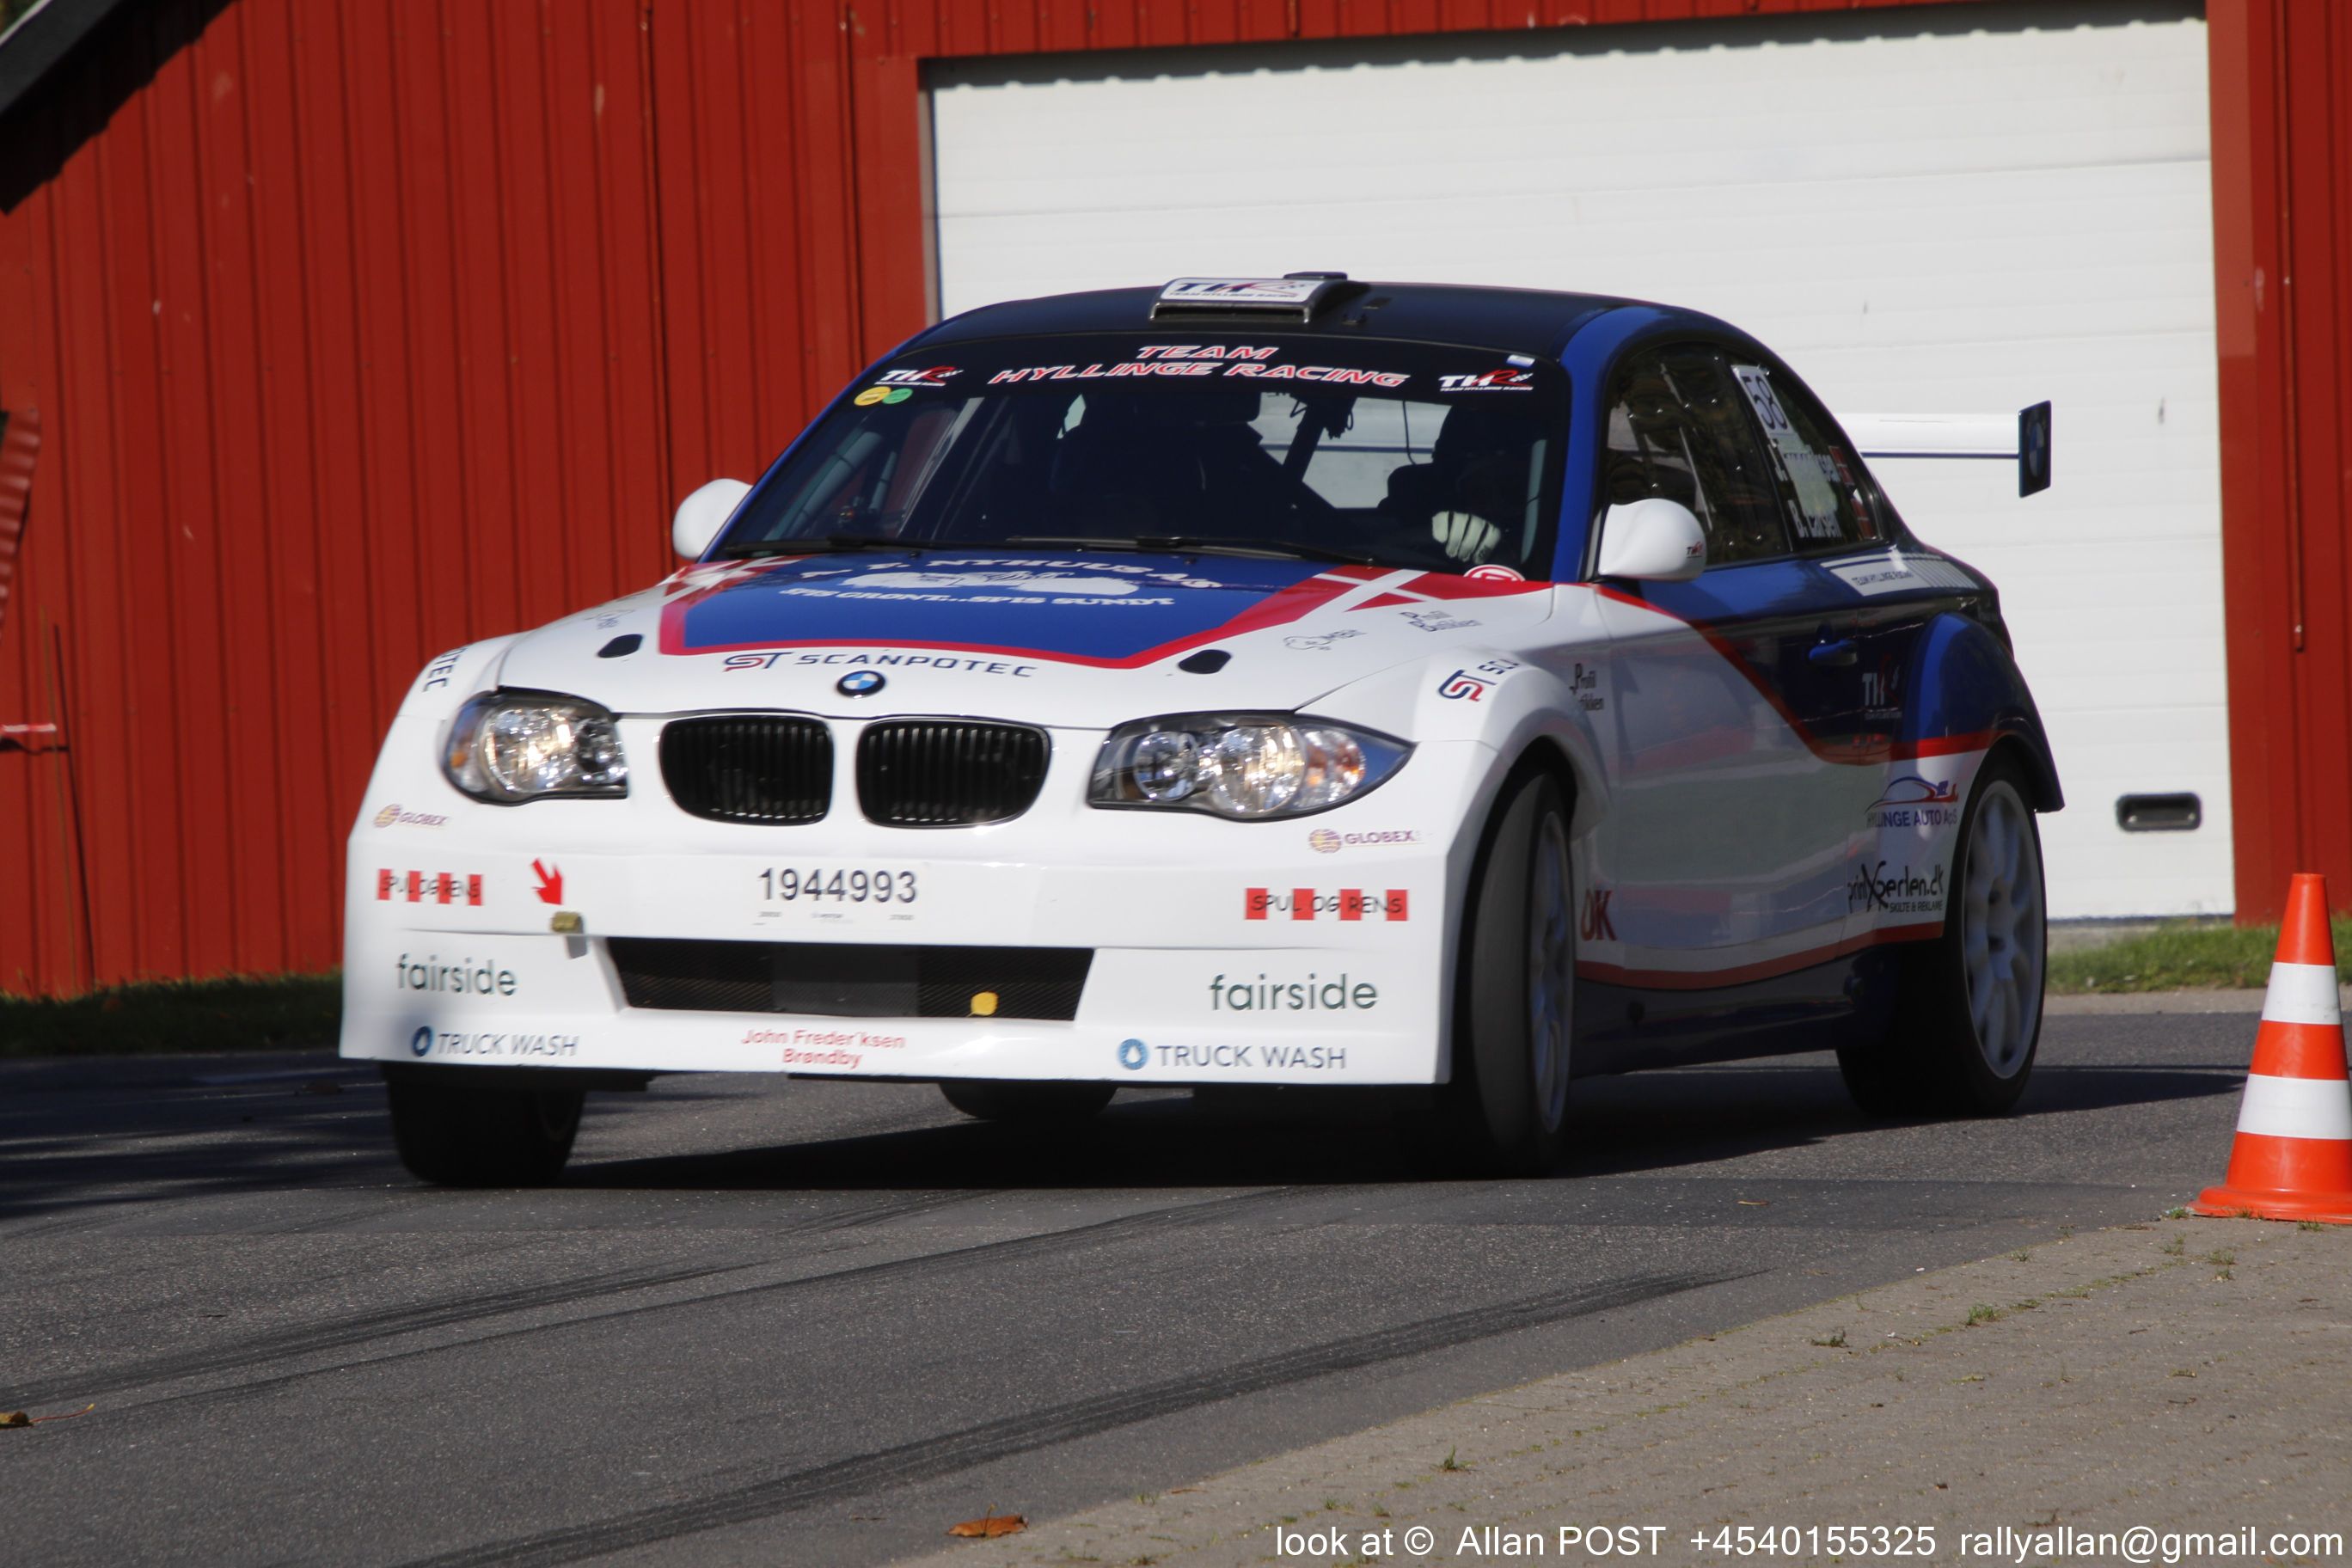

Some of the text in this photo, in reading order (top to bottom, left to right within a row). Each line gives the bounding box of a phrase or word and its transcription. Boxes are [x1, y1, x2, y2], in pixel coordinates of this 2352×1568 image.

[1136, 345, 1280, 360] TEAM
[987, 362, 1412, 388] HYLLINGE RACING
[1741, 375, 1788, 430] 58
[793, 653, 1038, 677] SCANPOTEC
[1914, 808, 1942, 827] AUTO
[1344, 830, 1416, 844] GLOBEX
[757, 867, 918, 903] 1944993
[1251, 894, 1404, 914] SPUL OG RENS
[396, 952, 518, 997] fairside
[1209, 972, 1379, 1011] fairside
[437, 1032, 582, 1057] TRUCK WASH
[741, 1029, 789, 1045] John
[1155, 1044, 1347, 1069] TRUCK WASH
